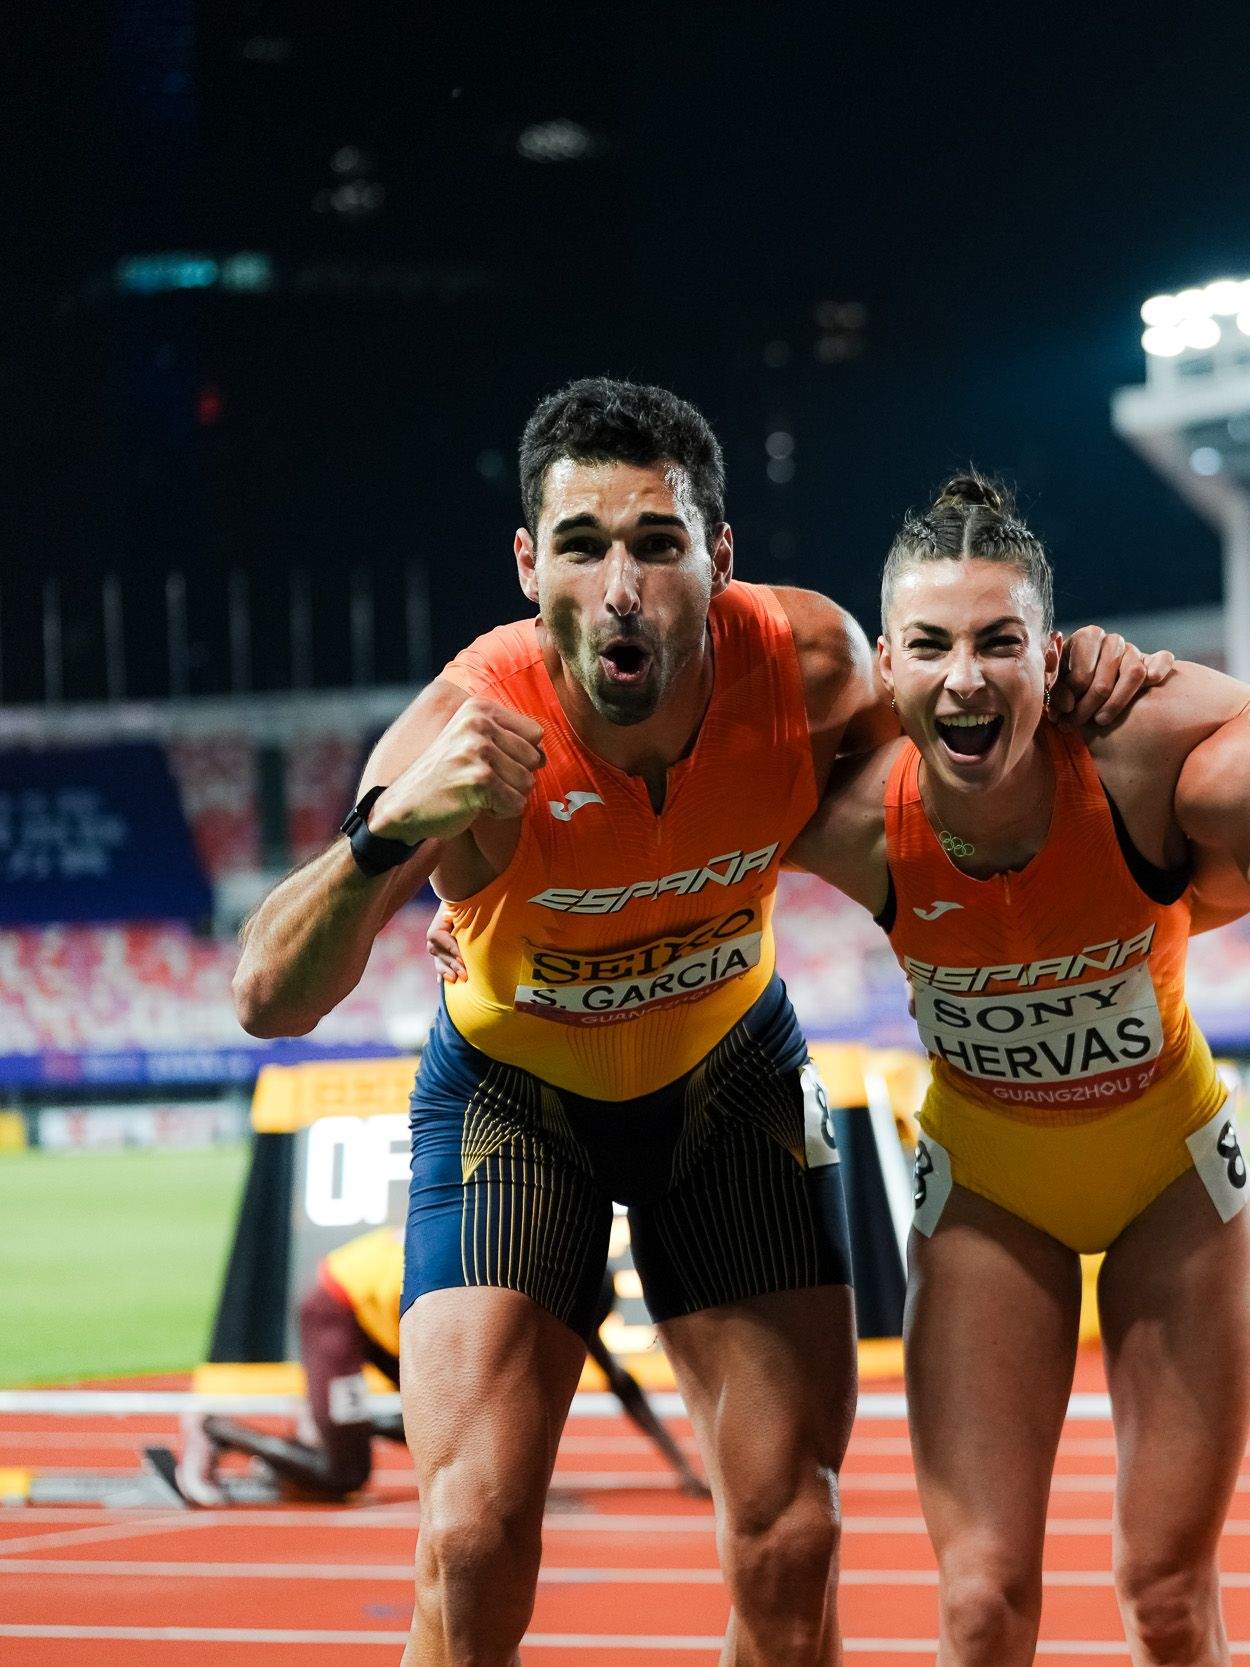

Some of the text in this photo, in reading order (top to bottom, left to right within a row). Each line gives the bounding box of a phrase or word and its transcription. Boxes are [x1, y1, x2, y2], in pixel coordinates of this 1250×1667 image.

[528, 842, 779, 914] ESPAÑA
[529, 946, 749, 1011] S. GARCÍA
[532, 908, 755, 985] SEIKO
[904, 923, 1157, 993] ESPAÑA
[933, 981, 1129, 1034] SONY
[933, 1016, 1151, 1079] HERVAS
[992, 1076, 1131, 1104] GUANGZHOU
[1217, 1119, 1247, 1190] 8
